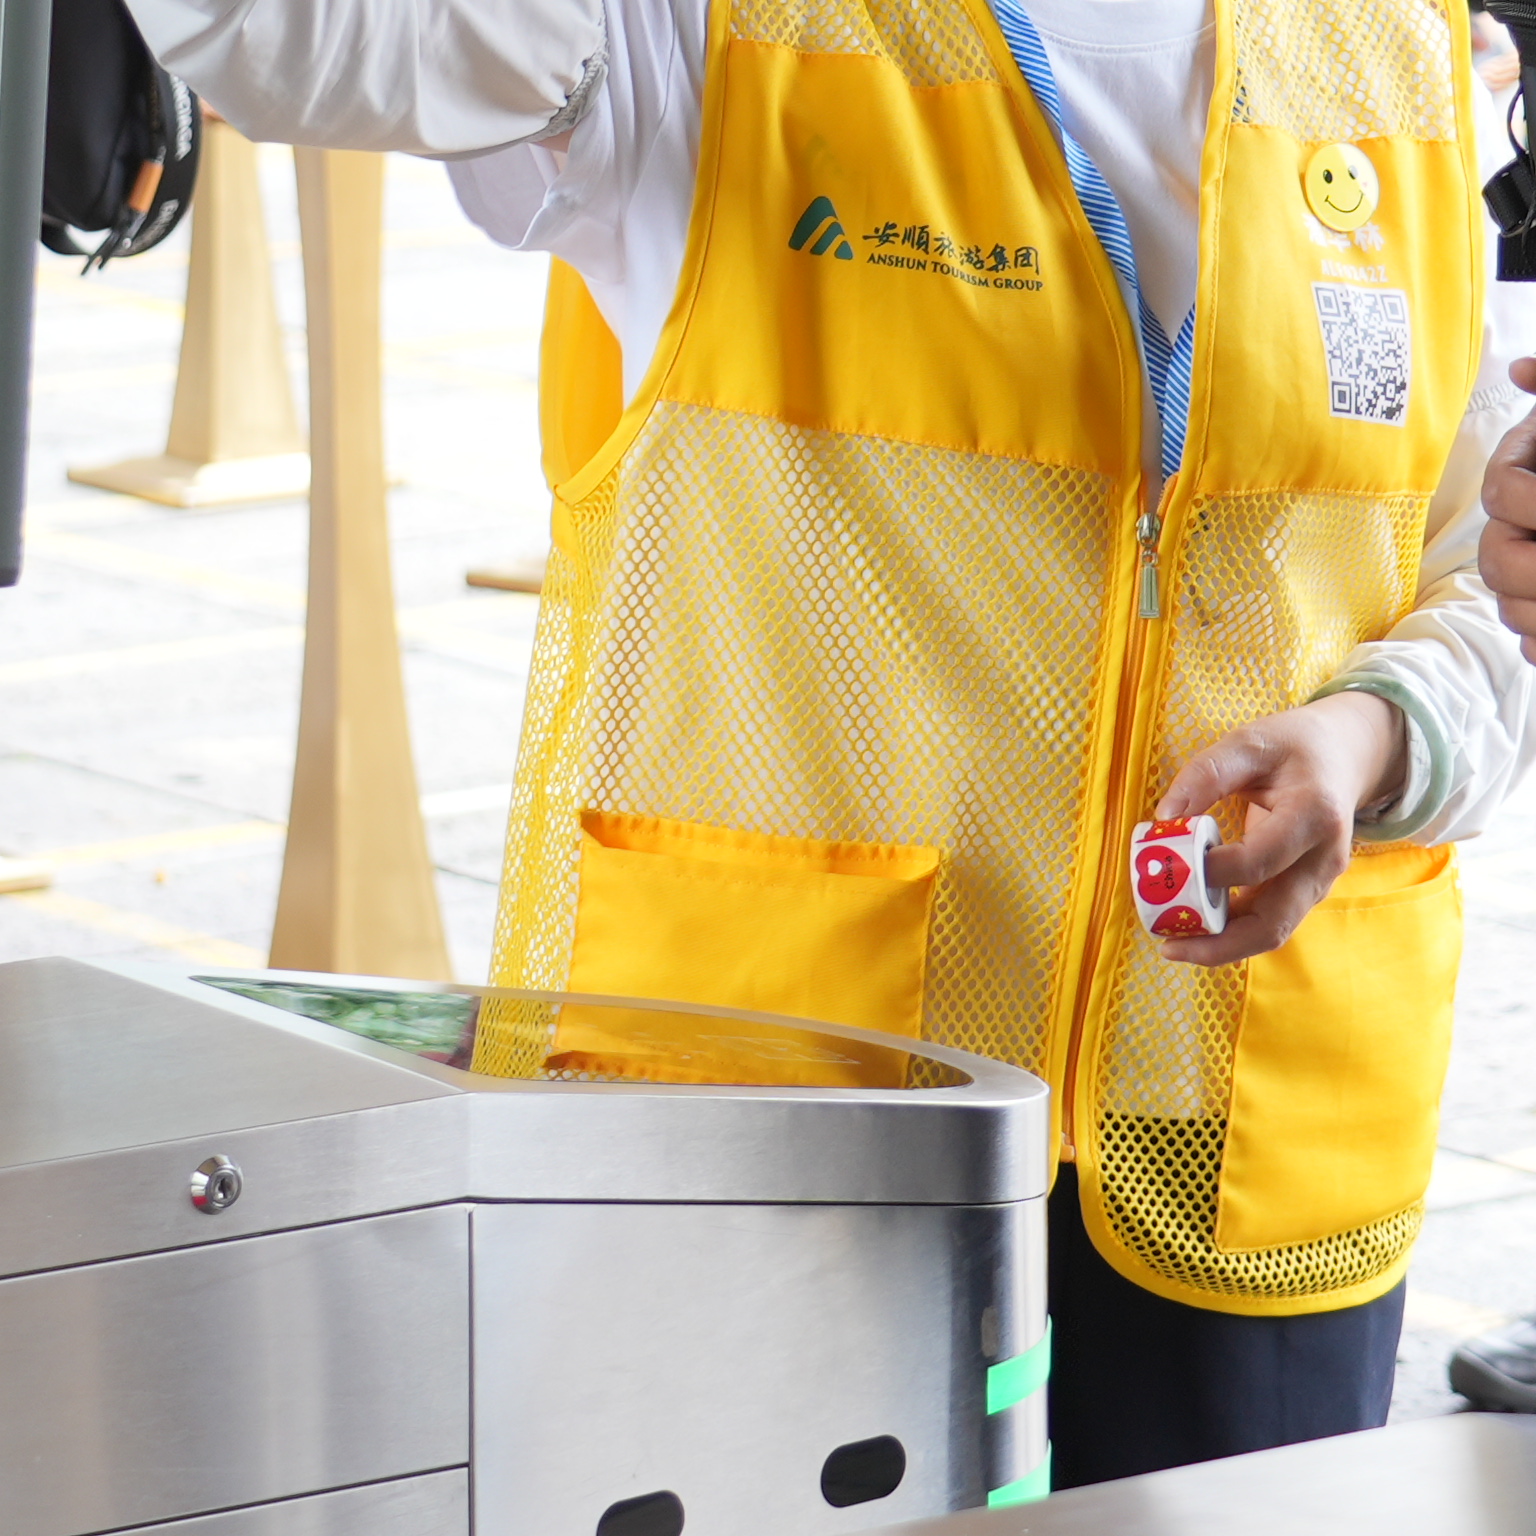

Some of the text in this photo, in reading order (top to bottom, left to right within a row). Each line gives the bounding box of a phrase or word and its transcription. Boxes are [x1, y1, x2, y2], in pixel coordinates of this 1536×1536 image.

[866, 252, 1044, 292] ANSHUN TOURISM GROUP
[1165, 855, 1175, 890] China
